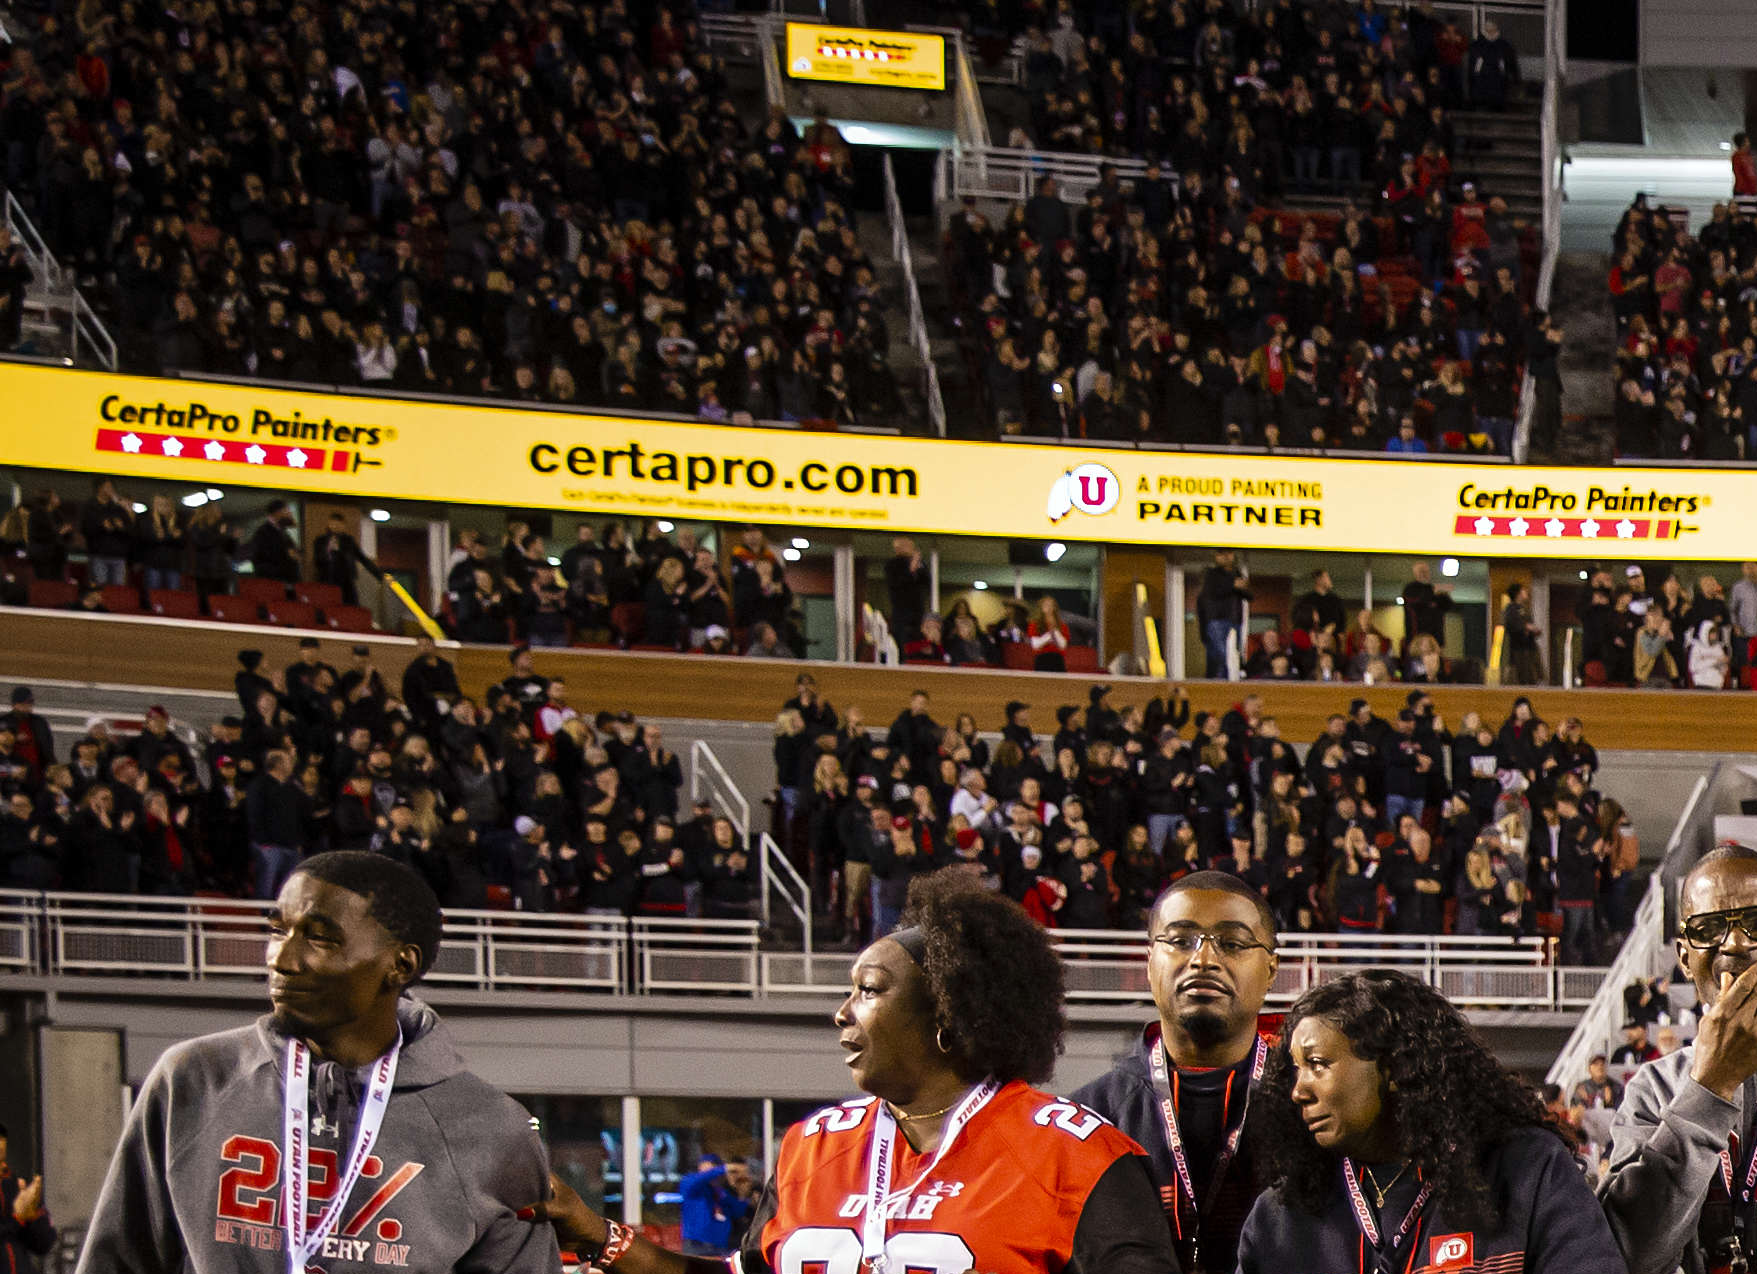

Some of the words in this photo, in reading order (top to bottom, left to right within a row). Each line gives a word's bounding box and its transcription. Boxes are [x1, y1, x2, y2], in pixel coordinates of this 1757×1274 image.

[99, 394, 240, 433] CertaPro
[251, 408, 382, 446] Painters
[528, 441, 919, 497] certapro.com
[1078, 475, 1108, 506] U
[1137, 476, 1150, 493] A
[1159, 477, 1224, 497] PROUD
[1232, 479, 1322, 499] PAINTING
[1459, 483, 1577, 510] CertaPro
[1586, 486, 1698, 512] Painters
[1139, 502, 1322, 526] PARTNER
[837, 1193, 944, 1221] UAH
[1353, 1191, 1380, 1249] FOOTBA
[374, 1242, 411, 1267] DAY
